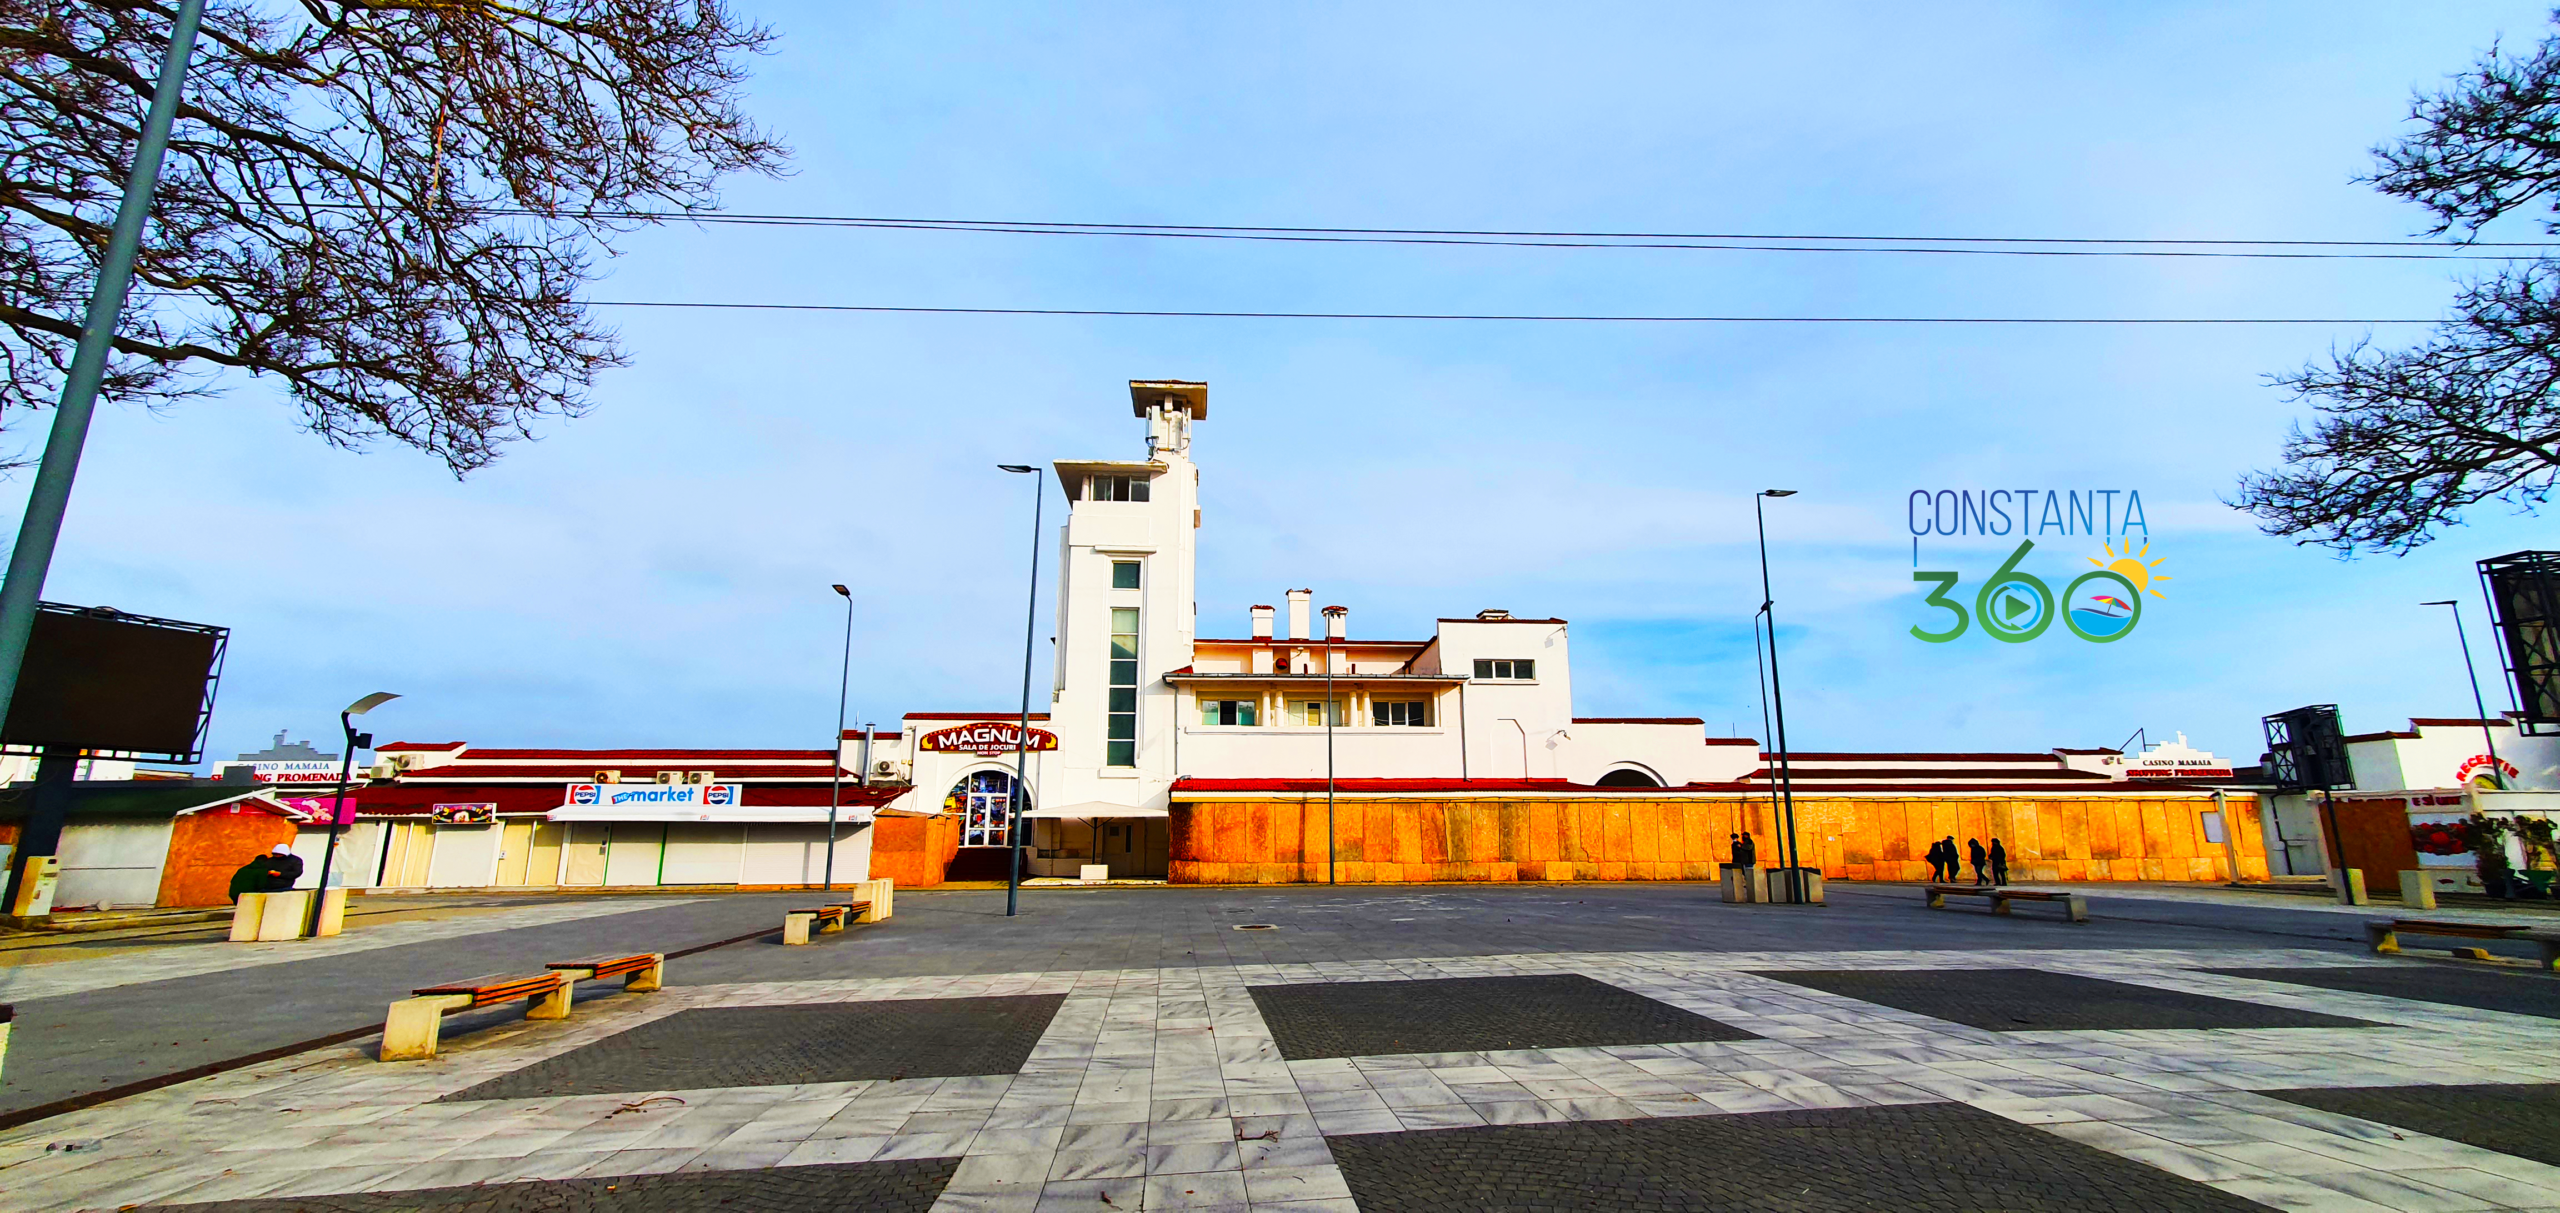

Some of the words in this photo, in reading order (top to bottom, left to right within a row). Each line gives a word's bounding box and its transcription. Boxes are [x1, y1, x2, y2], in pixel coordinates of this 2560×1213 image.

[938, 728, 1040, 749] MAGNUM
[284, 762, 330, 770] MAMAIA
[630, 786, 694, 802] market
